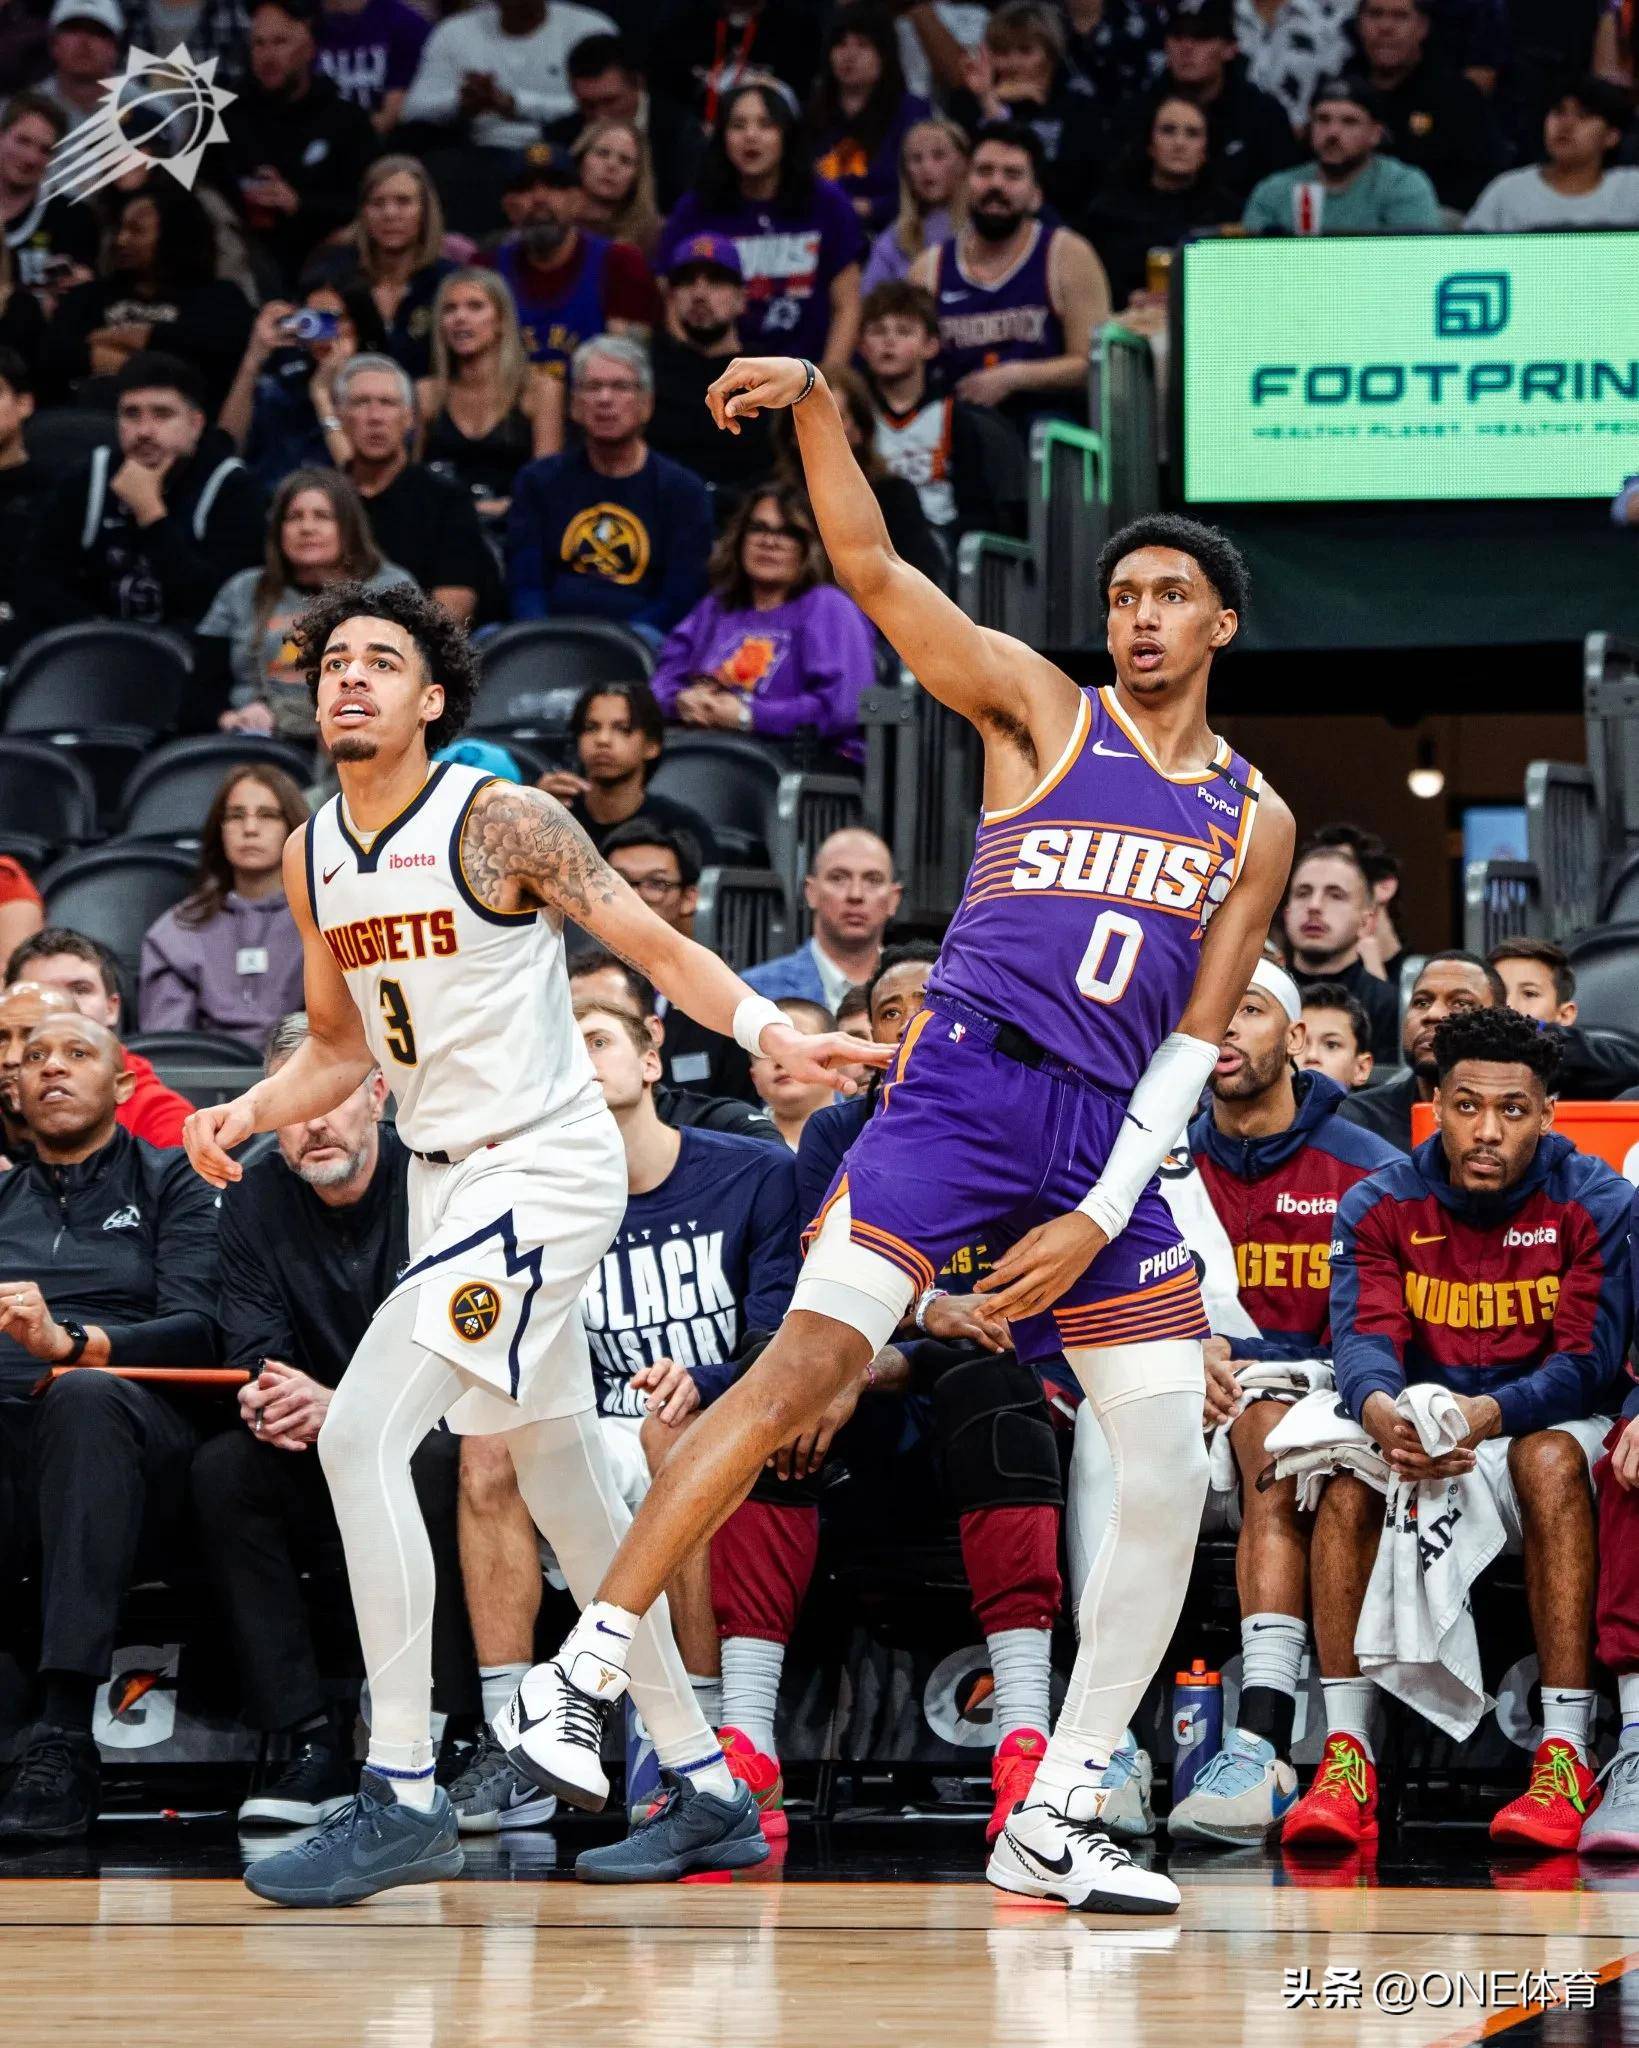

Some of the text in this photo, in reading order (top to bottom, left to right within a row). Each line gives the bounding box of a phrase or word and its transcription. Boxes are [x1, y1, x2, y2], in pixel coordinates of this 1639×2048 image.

[1252, 362, 1639, 406] FOOTPRIN
[1197, 785, 1240, 818] PayPal
[389, 854, 436, 870] ibotta
[1011, 828, 1211, 909] SUNS
[323, 909, 460, 974] NUGGETS
[1075, 909, 1145, 1006] 0
[378, 976, 419, 1070] 3
[670, 1220, 698, 1235] BY
[1276, 1193, 1338, 1216] ibotta
[1503, 1225, 1557, 1248] ibotta
[578, 1231, 736, 1331] BLACK
[1405, 1271, 1561, 1330] NUGGETS
[585, 1307, 737, 1374] HISTORY
[1172, 1711, 1195, 1746] G
